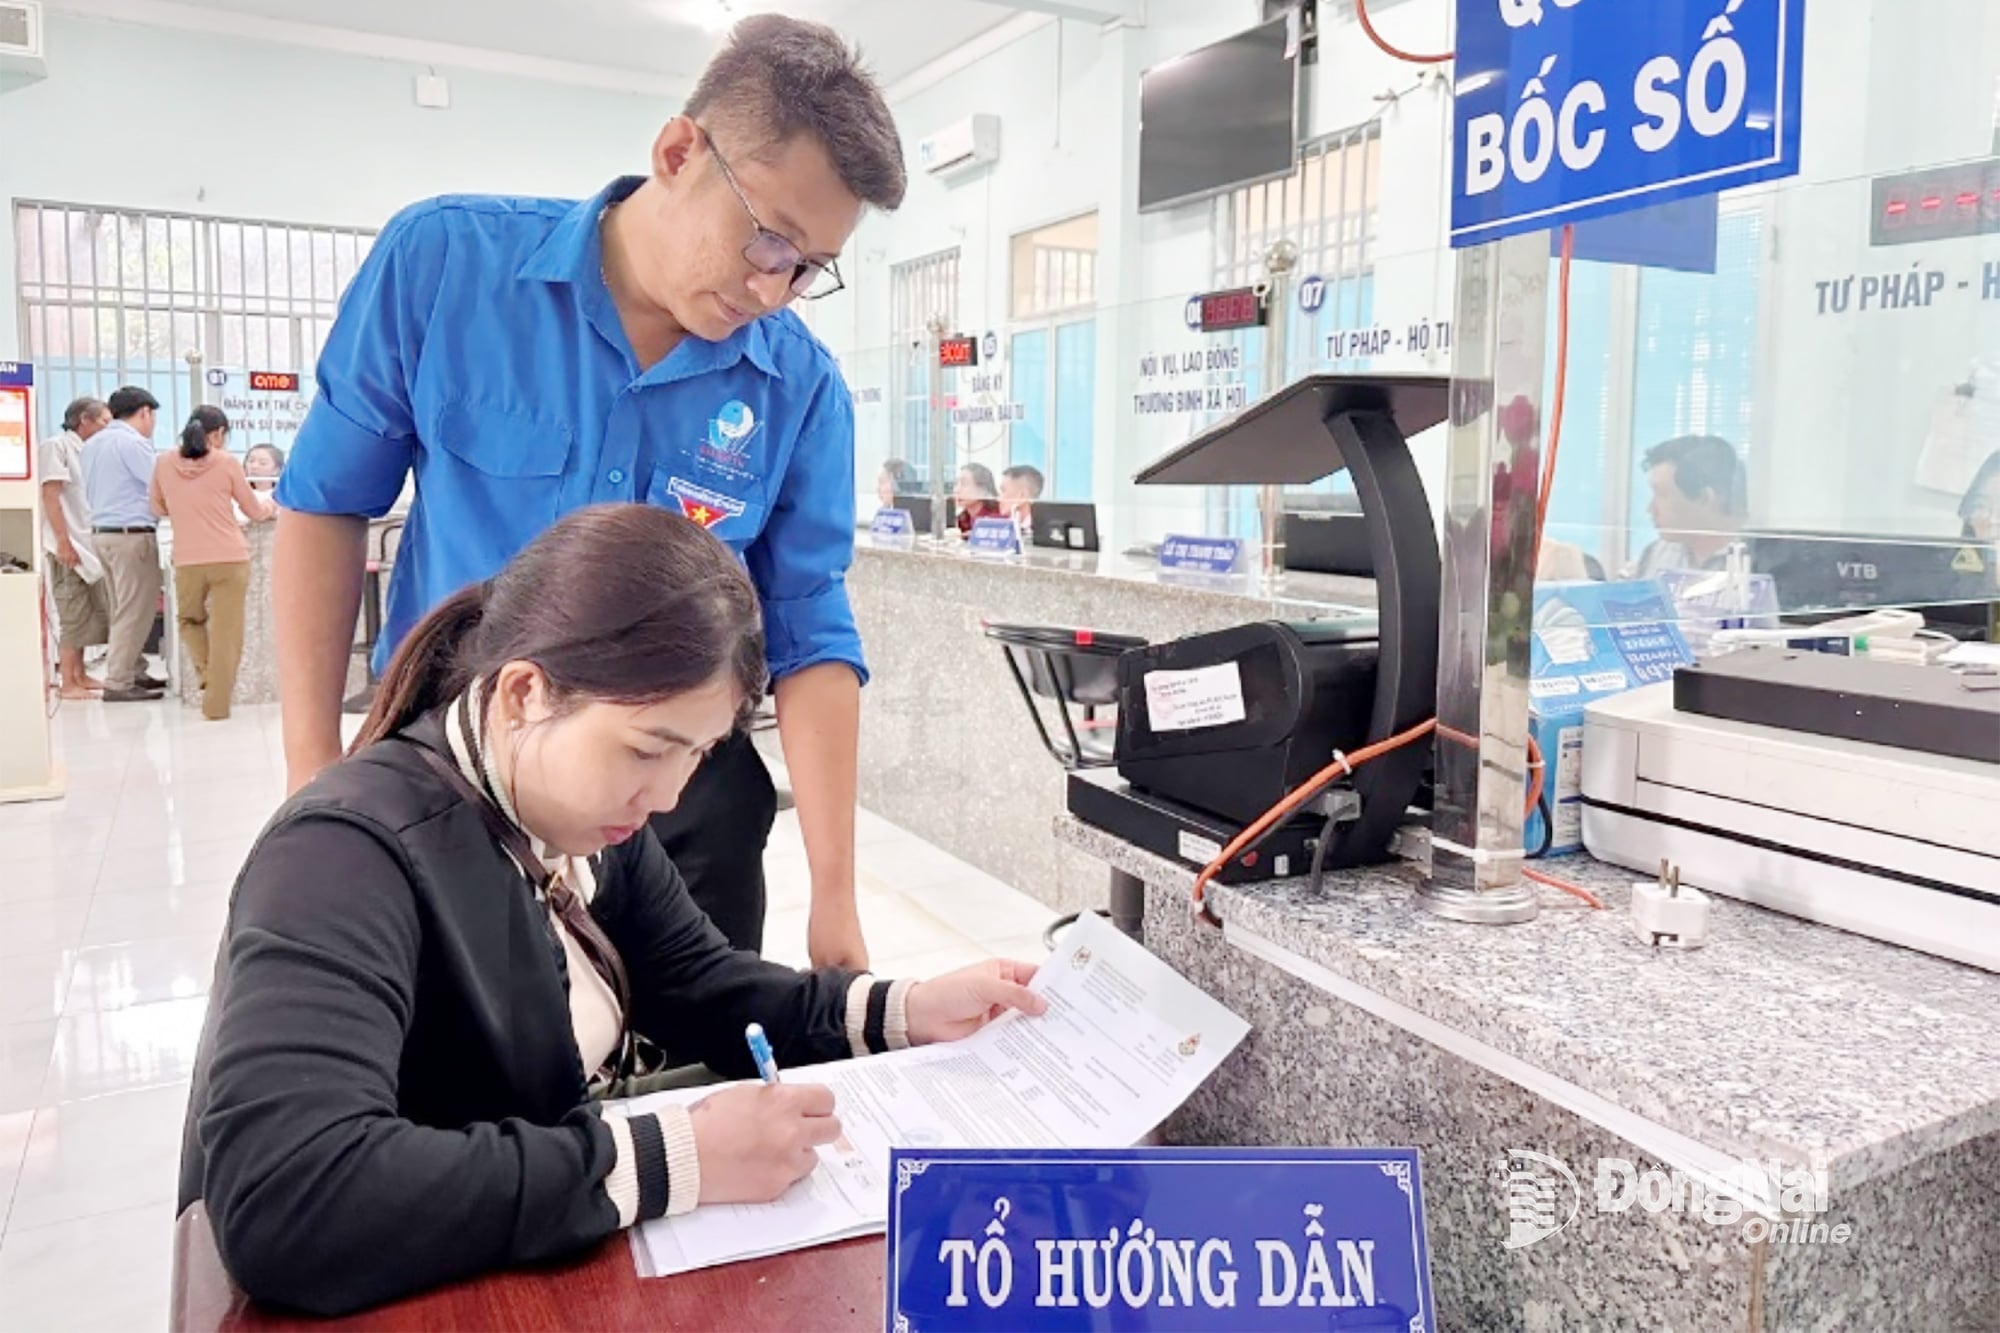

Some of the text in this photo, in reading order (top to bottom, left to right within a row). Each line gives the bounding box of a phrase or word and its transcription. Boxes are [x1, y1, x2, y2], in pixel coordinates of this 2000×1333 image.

[1465, 0, 1747, 196] BỐC SỐ
[1301, 280, 1324, 308] 07
[1816, 274, 1855, 315] TƯ
[1859, 260, 1945, 312] PHÁP
[1182, 350, 1203, 374] LAO
[1207, 343, 1239, 376] ĐỘNG
[1327, 331, 1345, 360] TƯ
[1350, 323, 1391, 357] PHÁP
[1408, 316, 1431, 358] HỘ
[1836, 561, 1878, 580] VTB
[938, 1197, 1376, 1309] TỔ HƯỚNG DẪN
